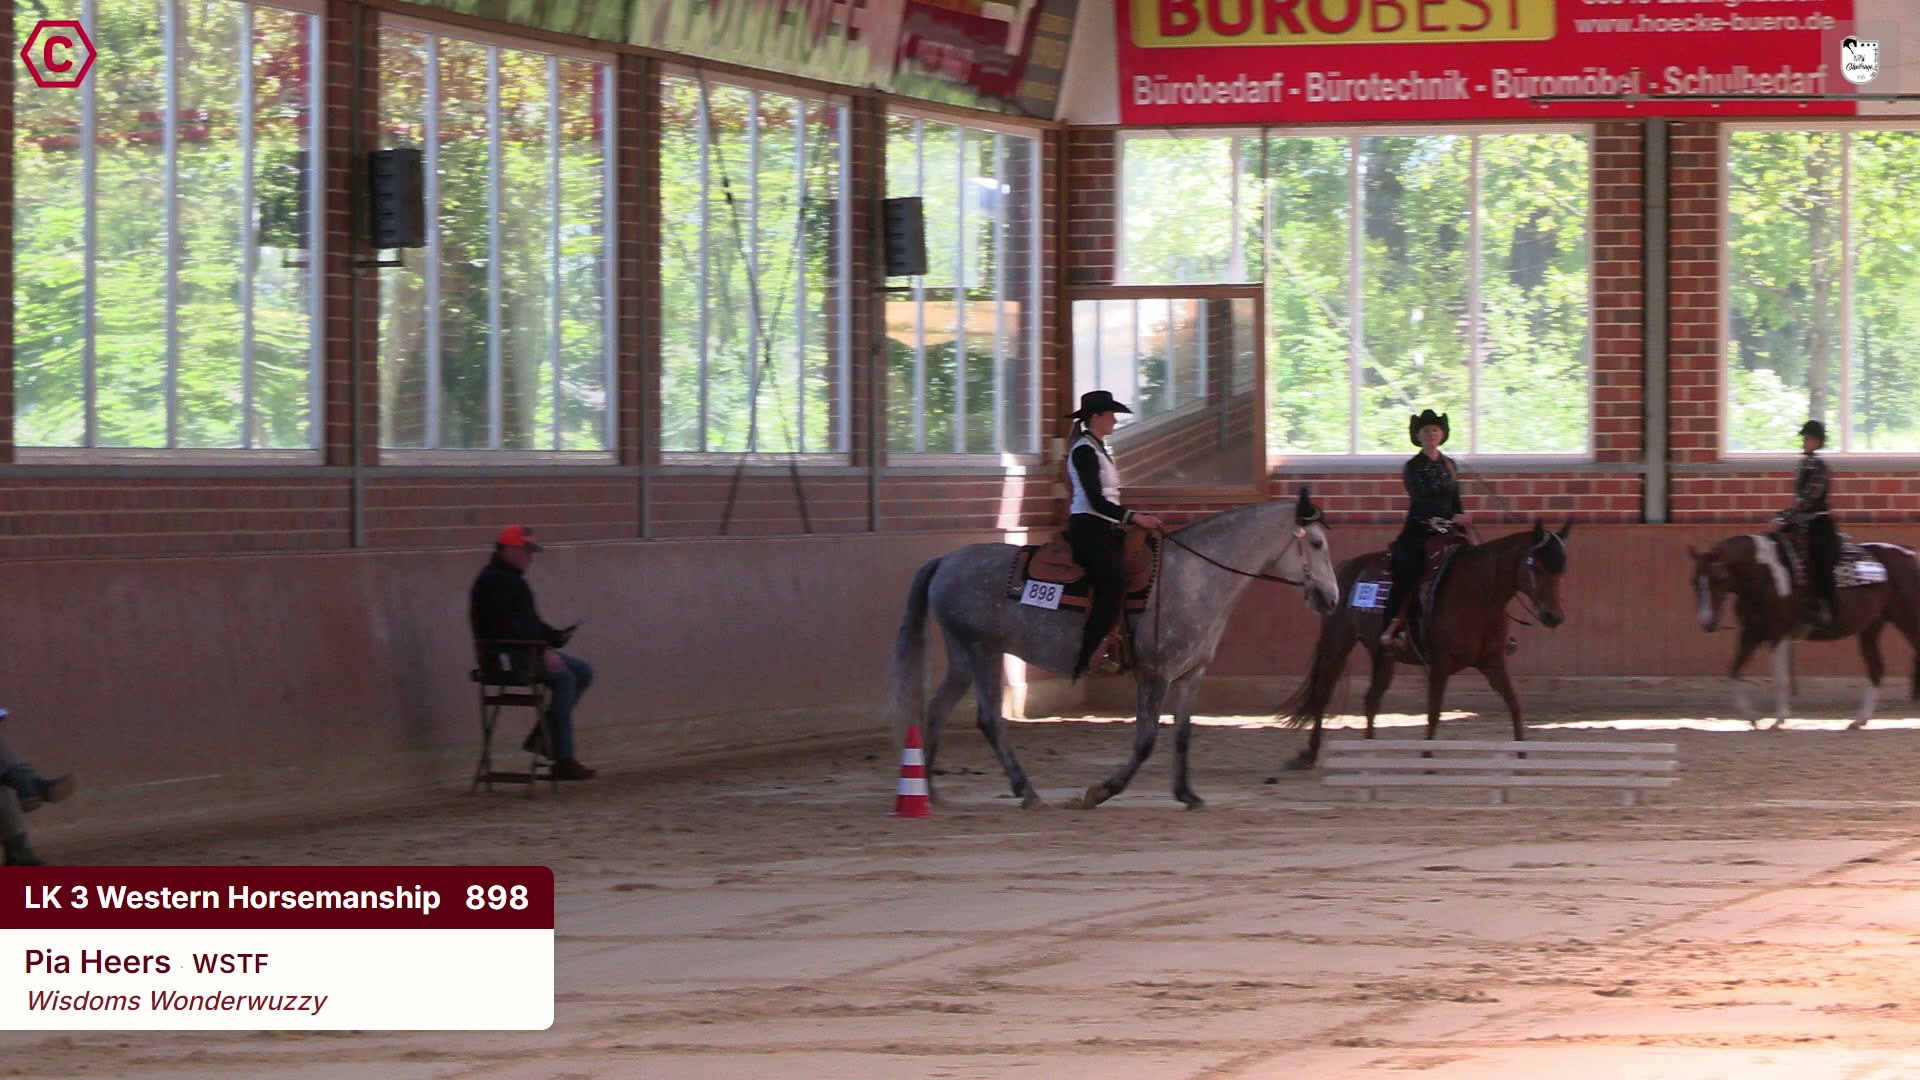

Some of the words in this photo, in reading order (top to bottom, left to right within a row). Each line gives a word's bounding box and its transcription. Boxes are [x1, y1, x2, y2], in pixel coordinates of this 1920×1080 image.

[1574, 11, 1836, 32] www.hoecke-buero.de
[1133, 72, 1283, 105] Bürobedarf
[1305, 69, 1470, 102] Bürotechnik
[1492, 67, 1641, 99] Büromöbel
[1664, 64, 1828, 94] Schulbedarf
[1029, 584, 1056, 602] 898
